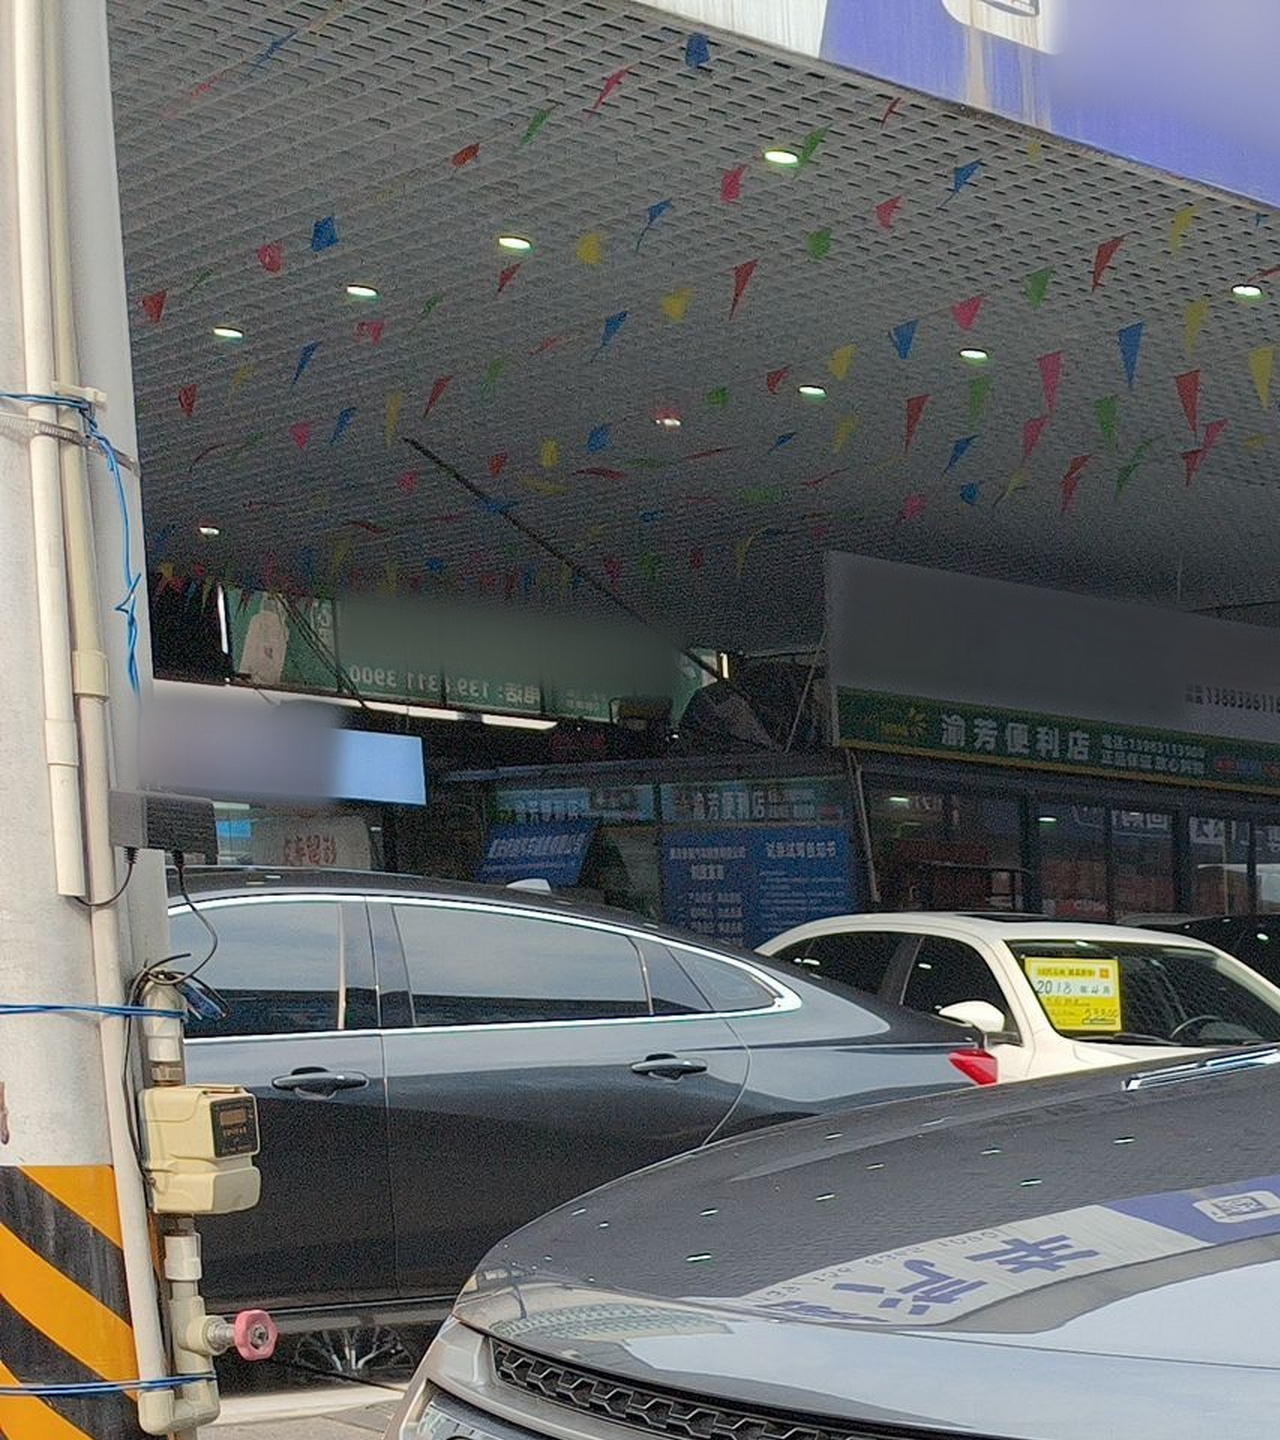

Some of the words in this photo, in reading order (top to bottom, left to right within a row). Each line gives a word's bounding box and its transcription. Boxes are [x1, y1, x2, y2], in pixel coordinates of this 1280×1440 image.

[940, 713, 1091, 761] 渝芳便利店
